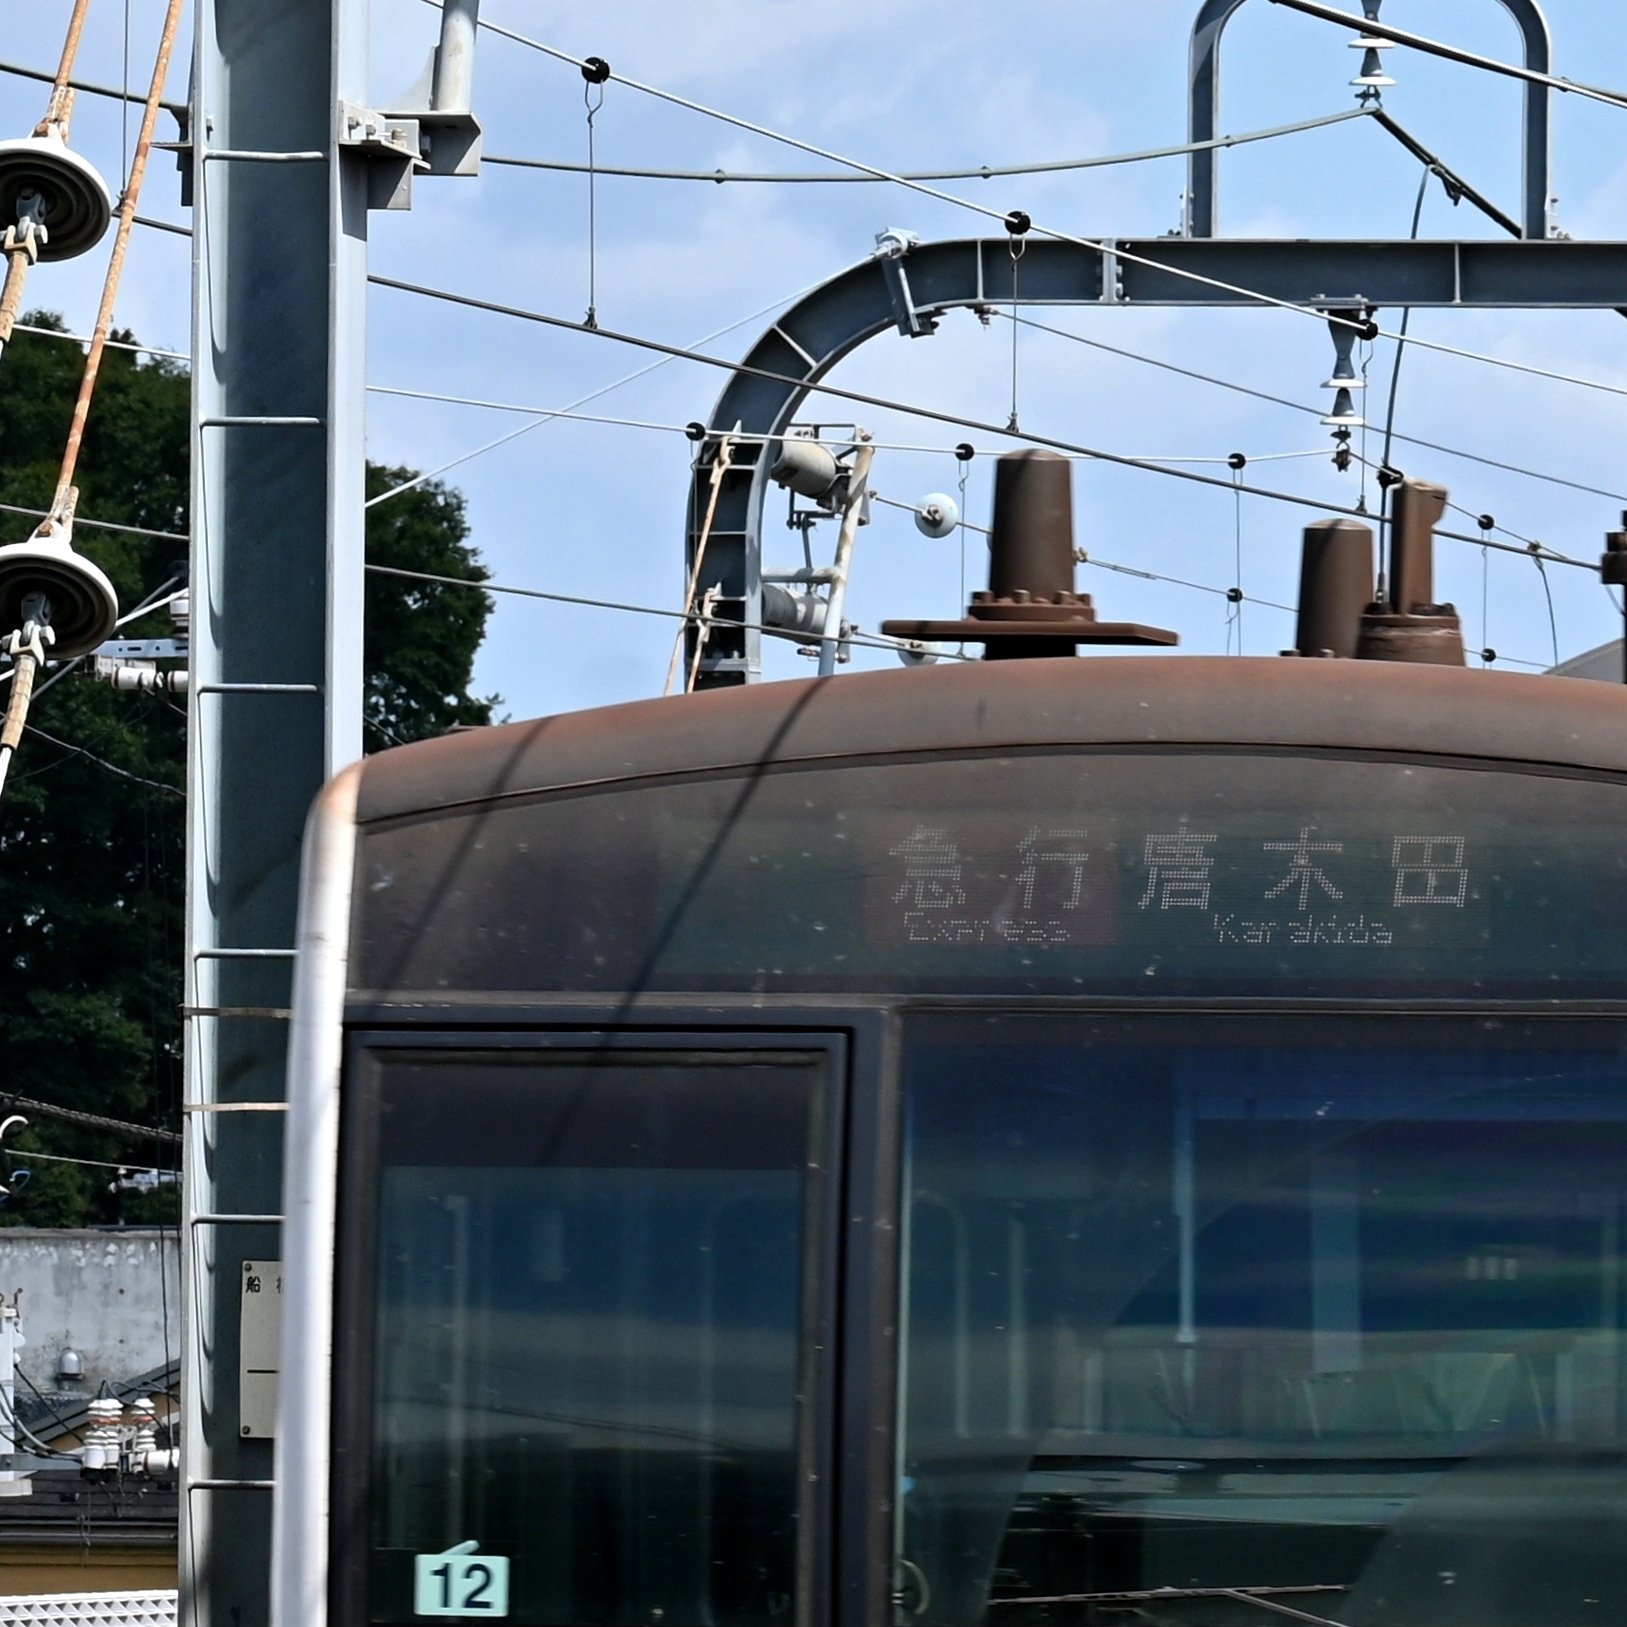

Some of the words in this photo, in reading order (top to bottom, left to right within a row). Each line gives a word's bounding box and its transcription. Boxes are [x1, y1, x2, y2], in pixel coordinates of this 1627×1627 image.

[889, 824, 1090, 909] 急行
[1137, 826, 1469, 911] 唐木田
[429, 1562, 494, 1610] 12
